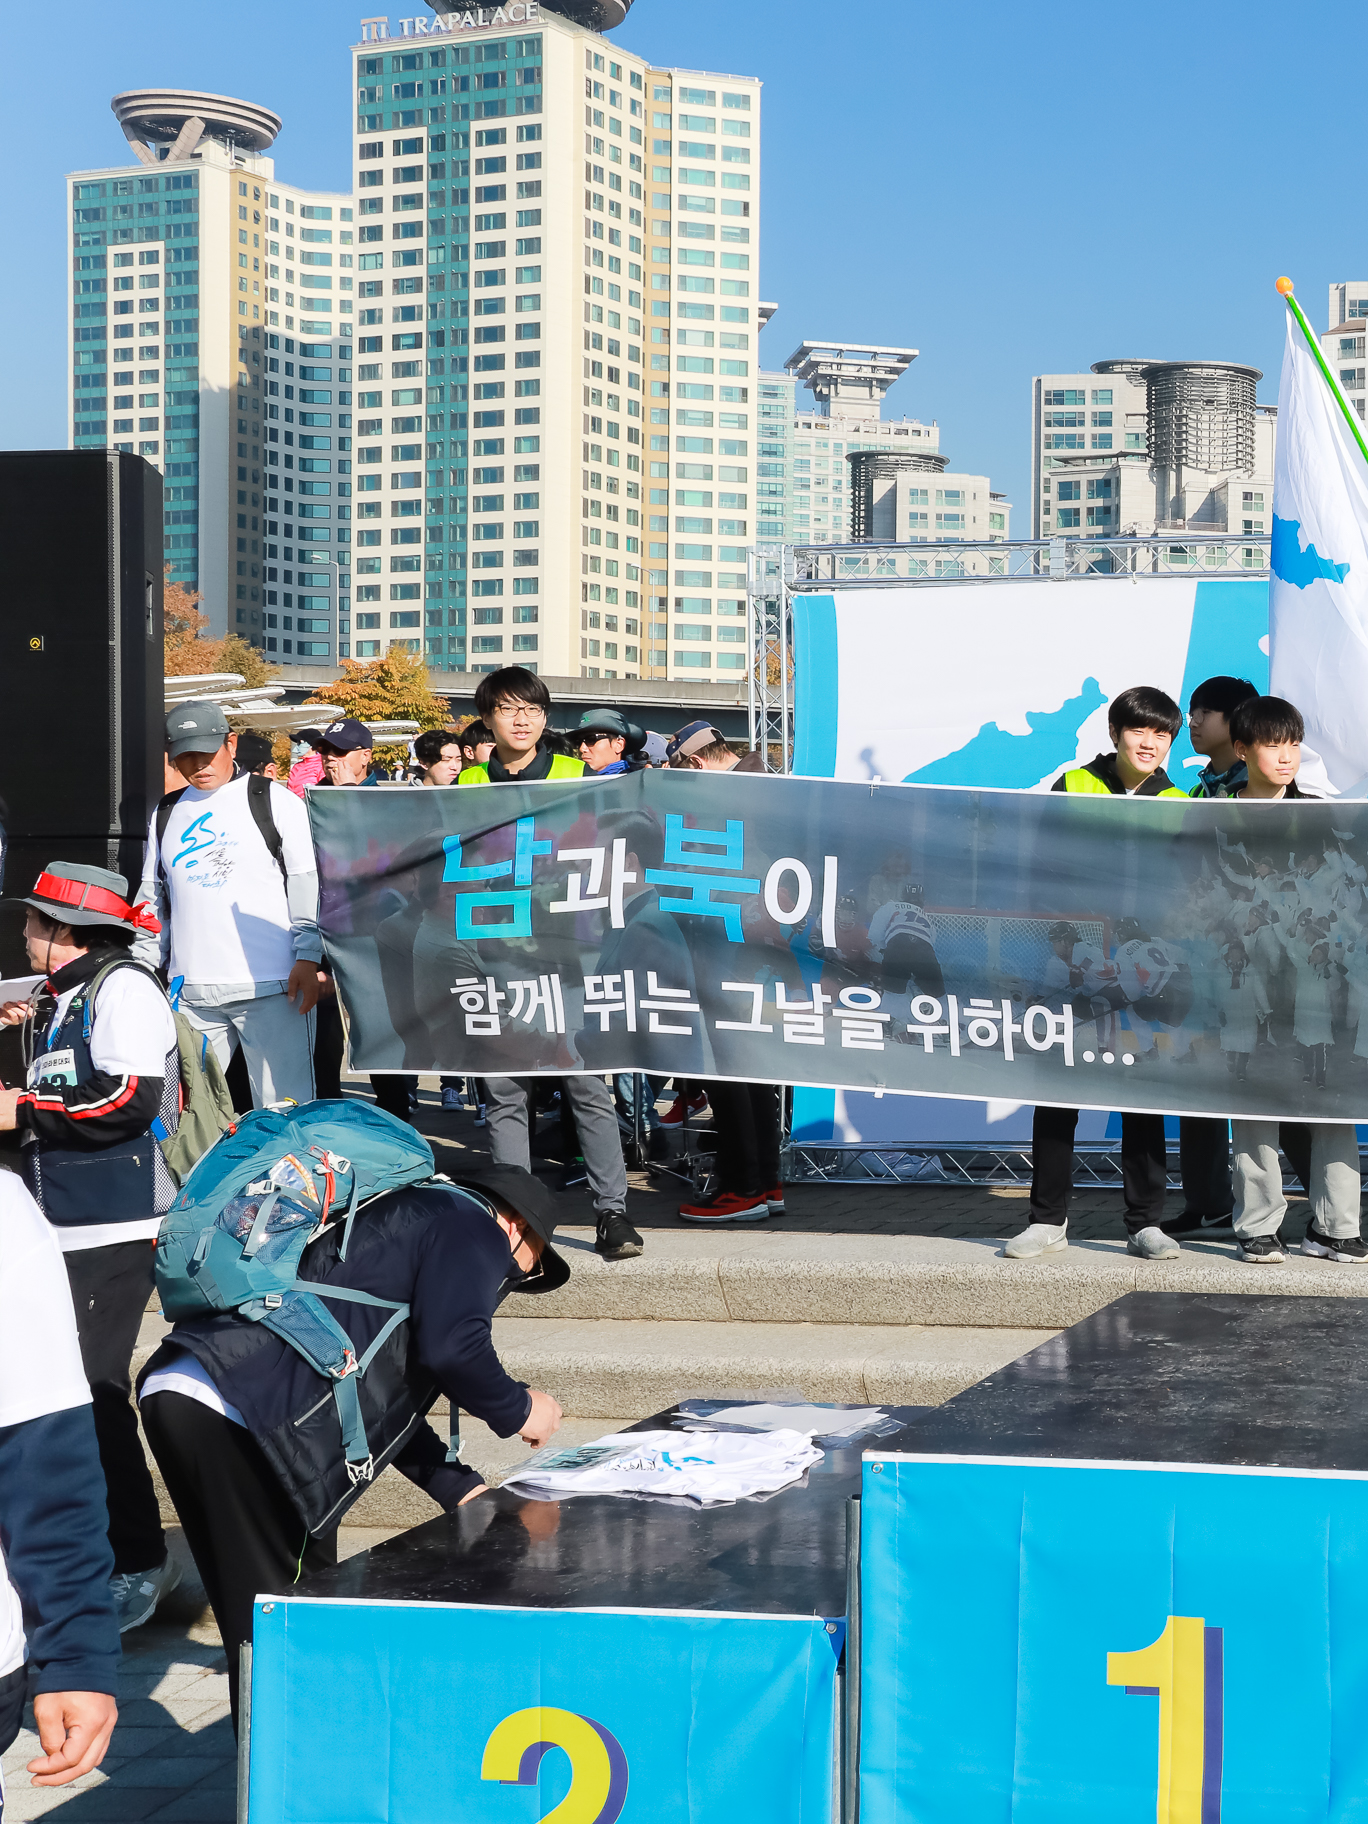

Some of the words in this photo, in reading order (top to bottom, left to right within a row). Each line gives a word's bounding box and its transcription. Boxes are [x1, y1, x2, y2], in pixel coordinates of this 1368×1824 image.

[399, 1, 538, 35] TRAPALACE
[441, 811, 840, 948] 남과북이
[449, 973, 568, 1038] 함께
[582, 970, 703, 1037] 뛰는
[715, 980, 893, 1053] 그날을
[907, 994, 1136, 1069] 위하여...
[480, 1706, 628, 1824] 2
[1106, 1614, 1223, 1824] 1
